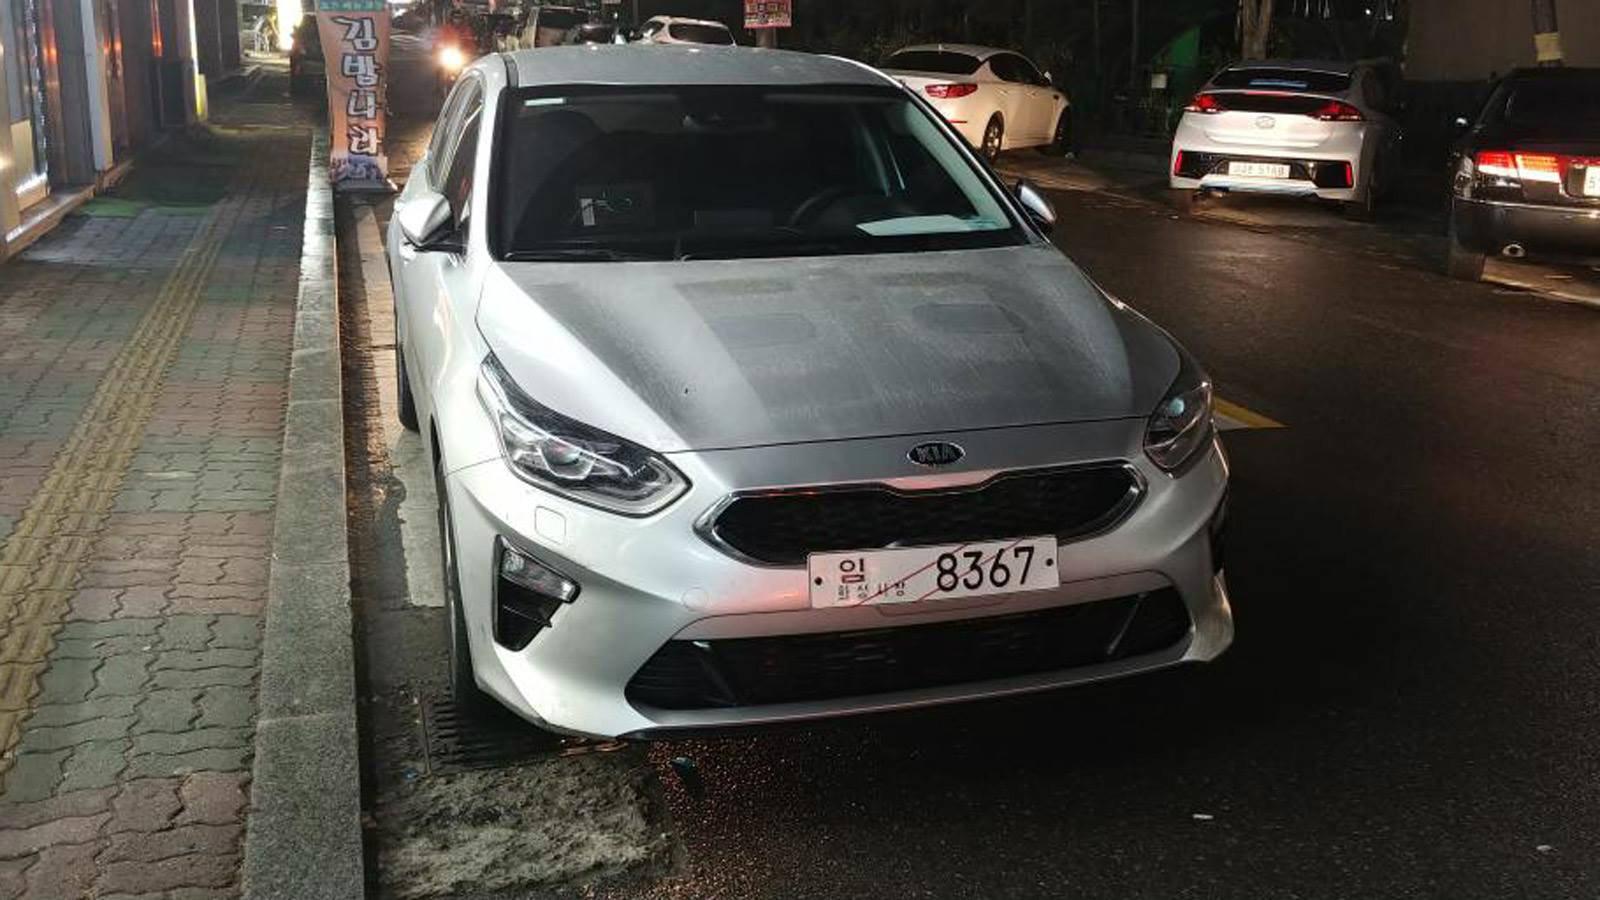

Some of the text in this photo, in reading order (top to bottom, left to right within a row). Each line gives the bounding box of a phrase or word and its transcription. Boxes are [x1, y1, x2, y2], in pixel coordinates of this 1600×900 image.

[915, 446, 957, 462] KIA
[839, 546, 1035, 592] 임 8367
